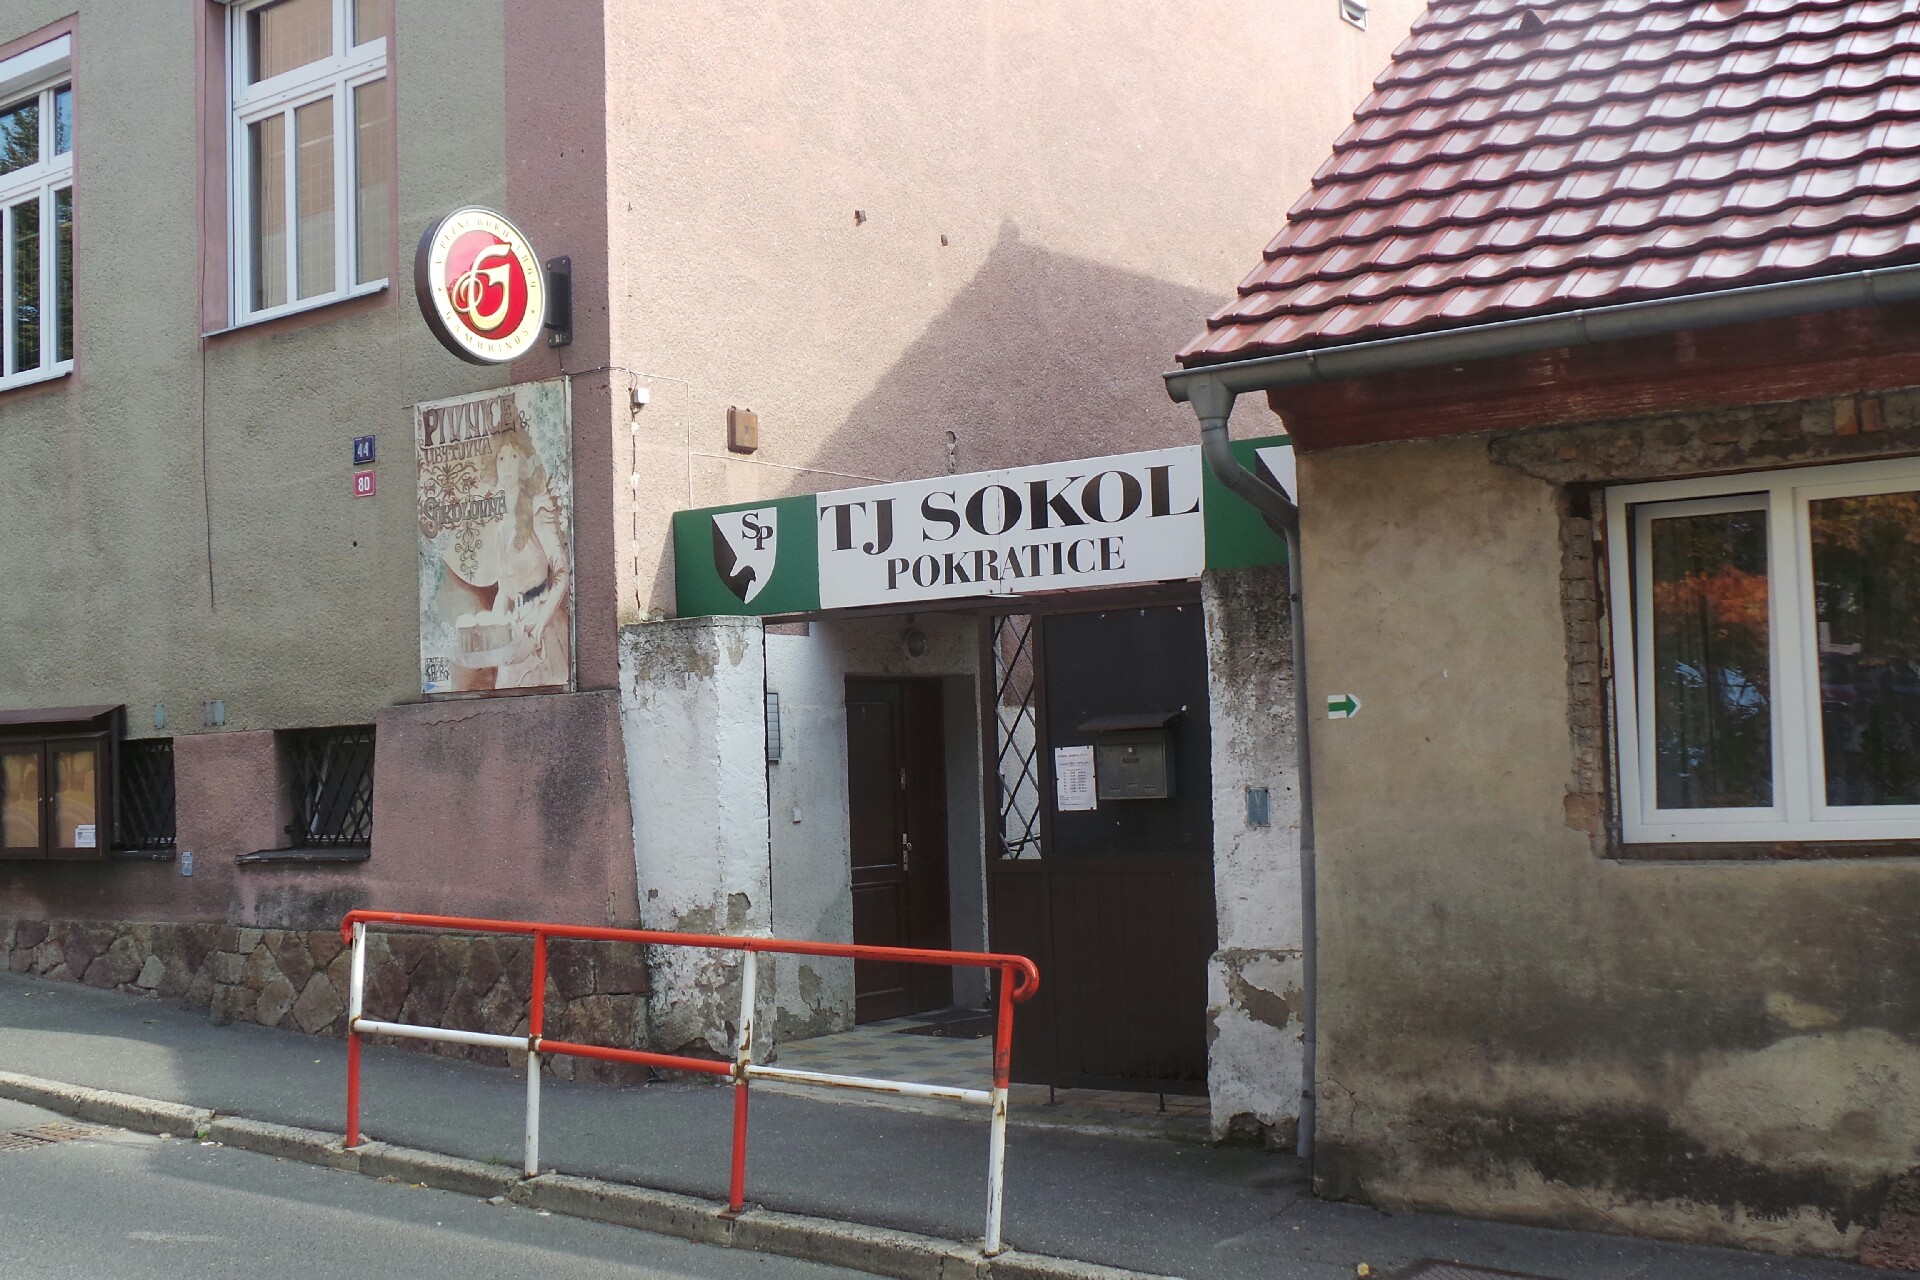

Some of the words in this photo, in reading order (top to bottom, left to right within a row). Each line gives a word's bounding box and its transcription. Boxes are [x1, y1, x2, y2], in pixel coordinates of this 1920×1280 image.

[422, 392, 517, 446] PIVNICE
[357, 441, 369, 458] 44
[358, 476, 371, 492] 80
[420, 496, 509, 539] SOKOLOVNA
[820, 498, 896, 555] TJ
[920, 464, 1200, 543] SOKOL
[885, 536, 1126, 591] POKRATICE
